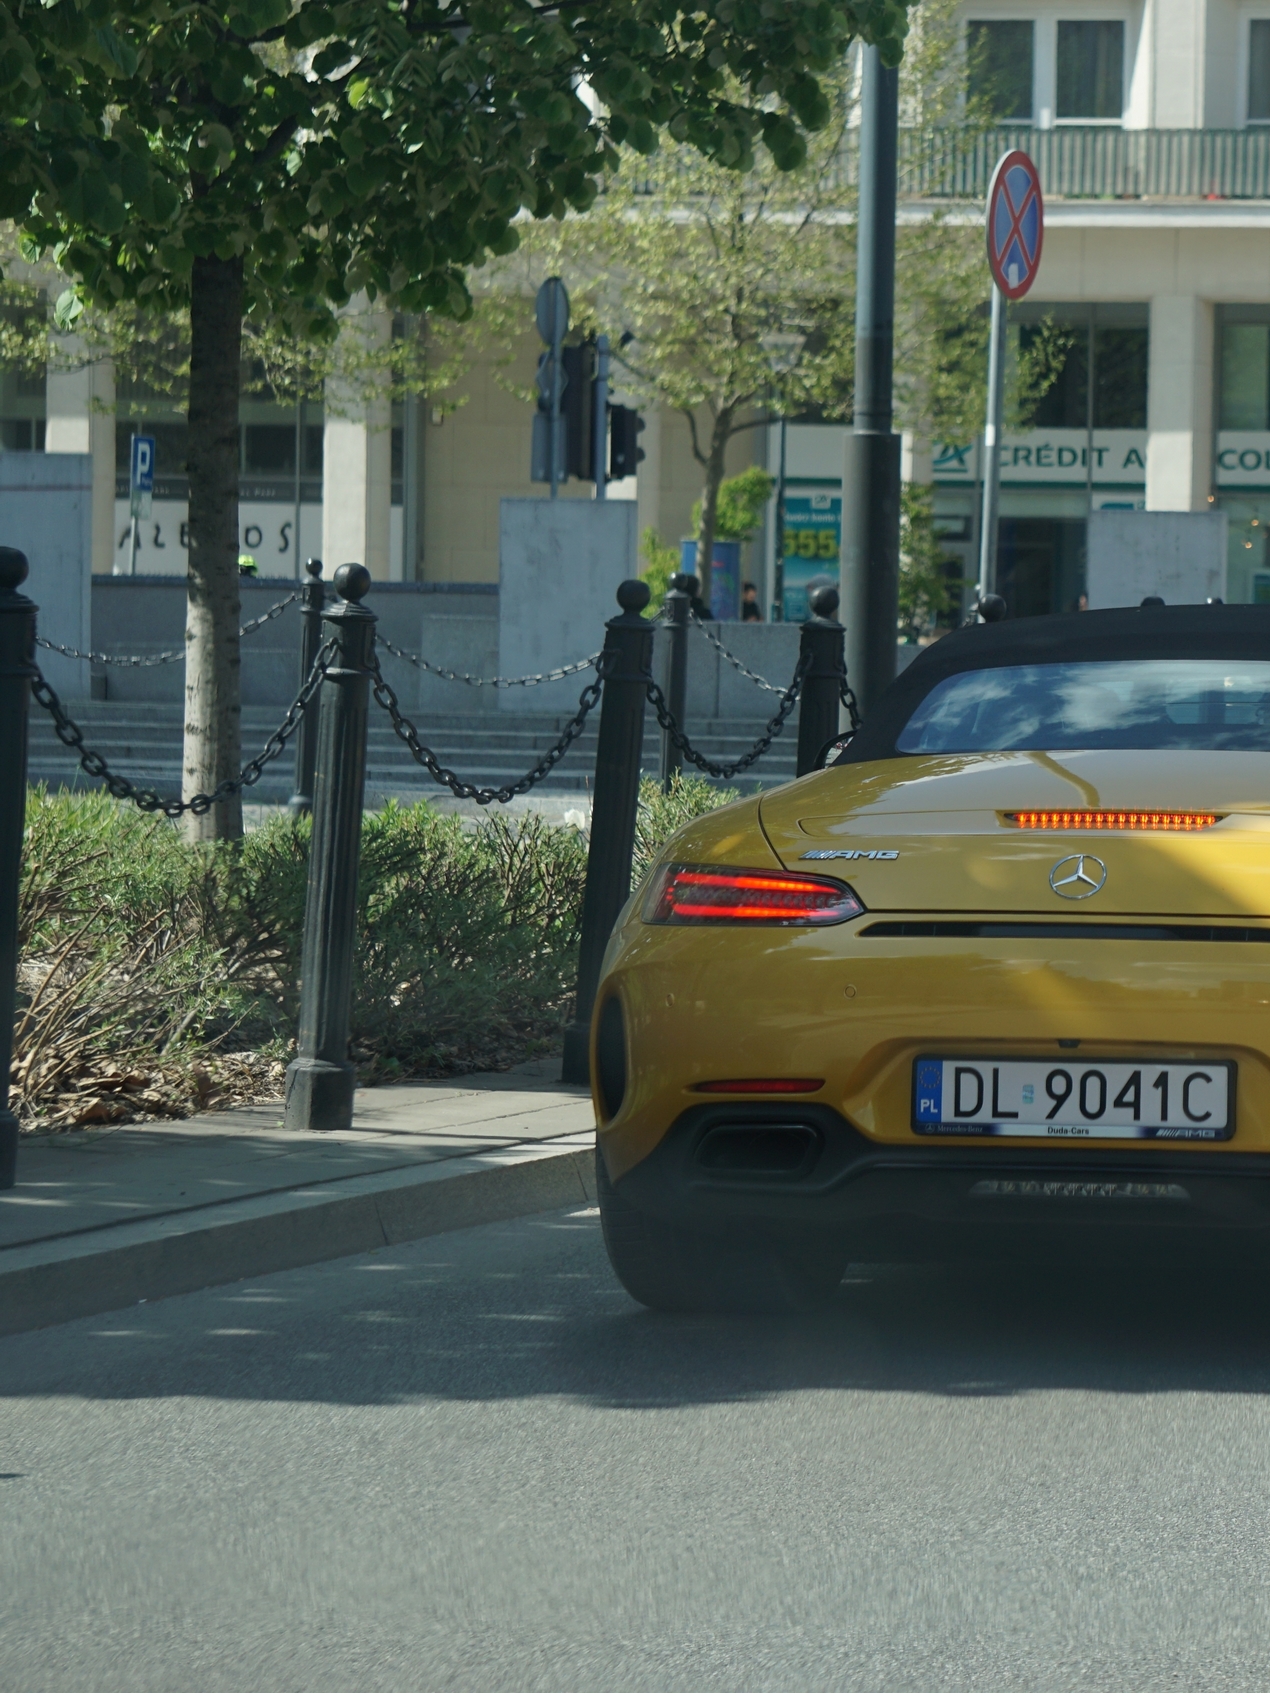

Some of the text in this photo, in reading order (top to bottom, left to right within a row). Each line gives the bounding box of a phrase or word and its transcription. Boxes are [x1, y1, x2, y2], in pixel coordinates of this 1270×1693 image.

[136, 442, 150, 487] P
[920, 1066, 1213, 1122] PL DL 9041C
[1047, 1126, 1090, 1136] Duda-Cars
